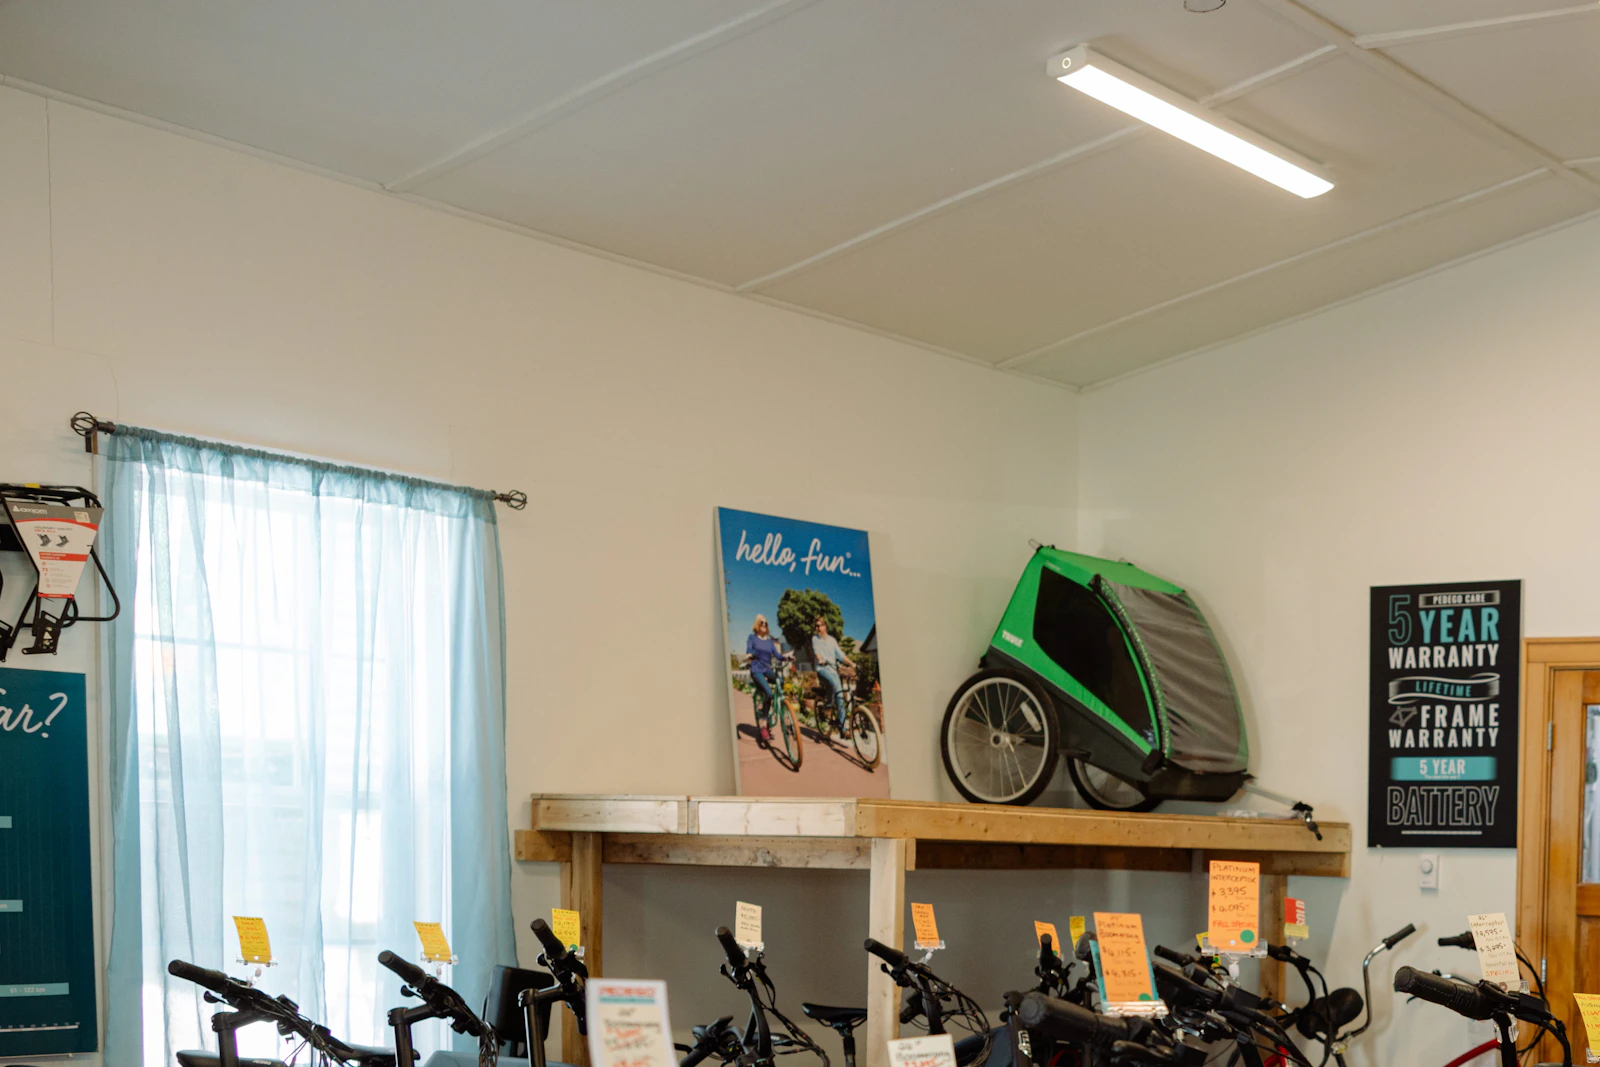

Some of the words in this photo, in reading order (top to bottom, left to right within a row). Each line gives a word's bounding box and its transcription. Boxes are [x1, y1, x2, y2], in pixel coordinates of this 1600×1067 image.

[736, 529, 797, 573] hello,
[1433, 594, 1464, 605] PEDEGO
[1465, 593, 1486, 604] CARE
[1388, 594, 1413, 646] 5
[1418, 607, 1499, 644] YEAR
[1388, 643, 1499, 669] WARRANTY
[1415, 680, 1472, 698] LIFETIME
[0, 688, 68, 739] ar?
[1421, 703, 1499, 728] FRAME
[1388, 727, 1499, 748] WARRANTY
[1419, 759, 1428, 775] 5
[1432, 759, 1466, 775] YEAR
[1386, 785, 1500, 826] BATTERY
[1212, 862, 1256, 874] PLATINUM
[599, 986, 657, 997] PEDEGO
